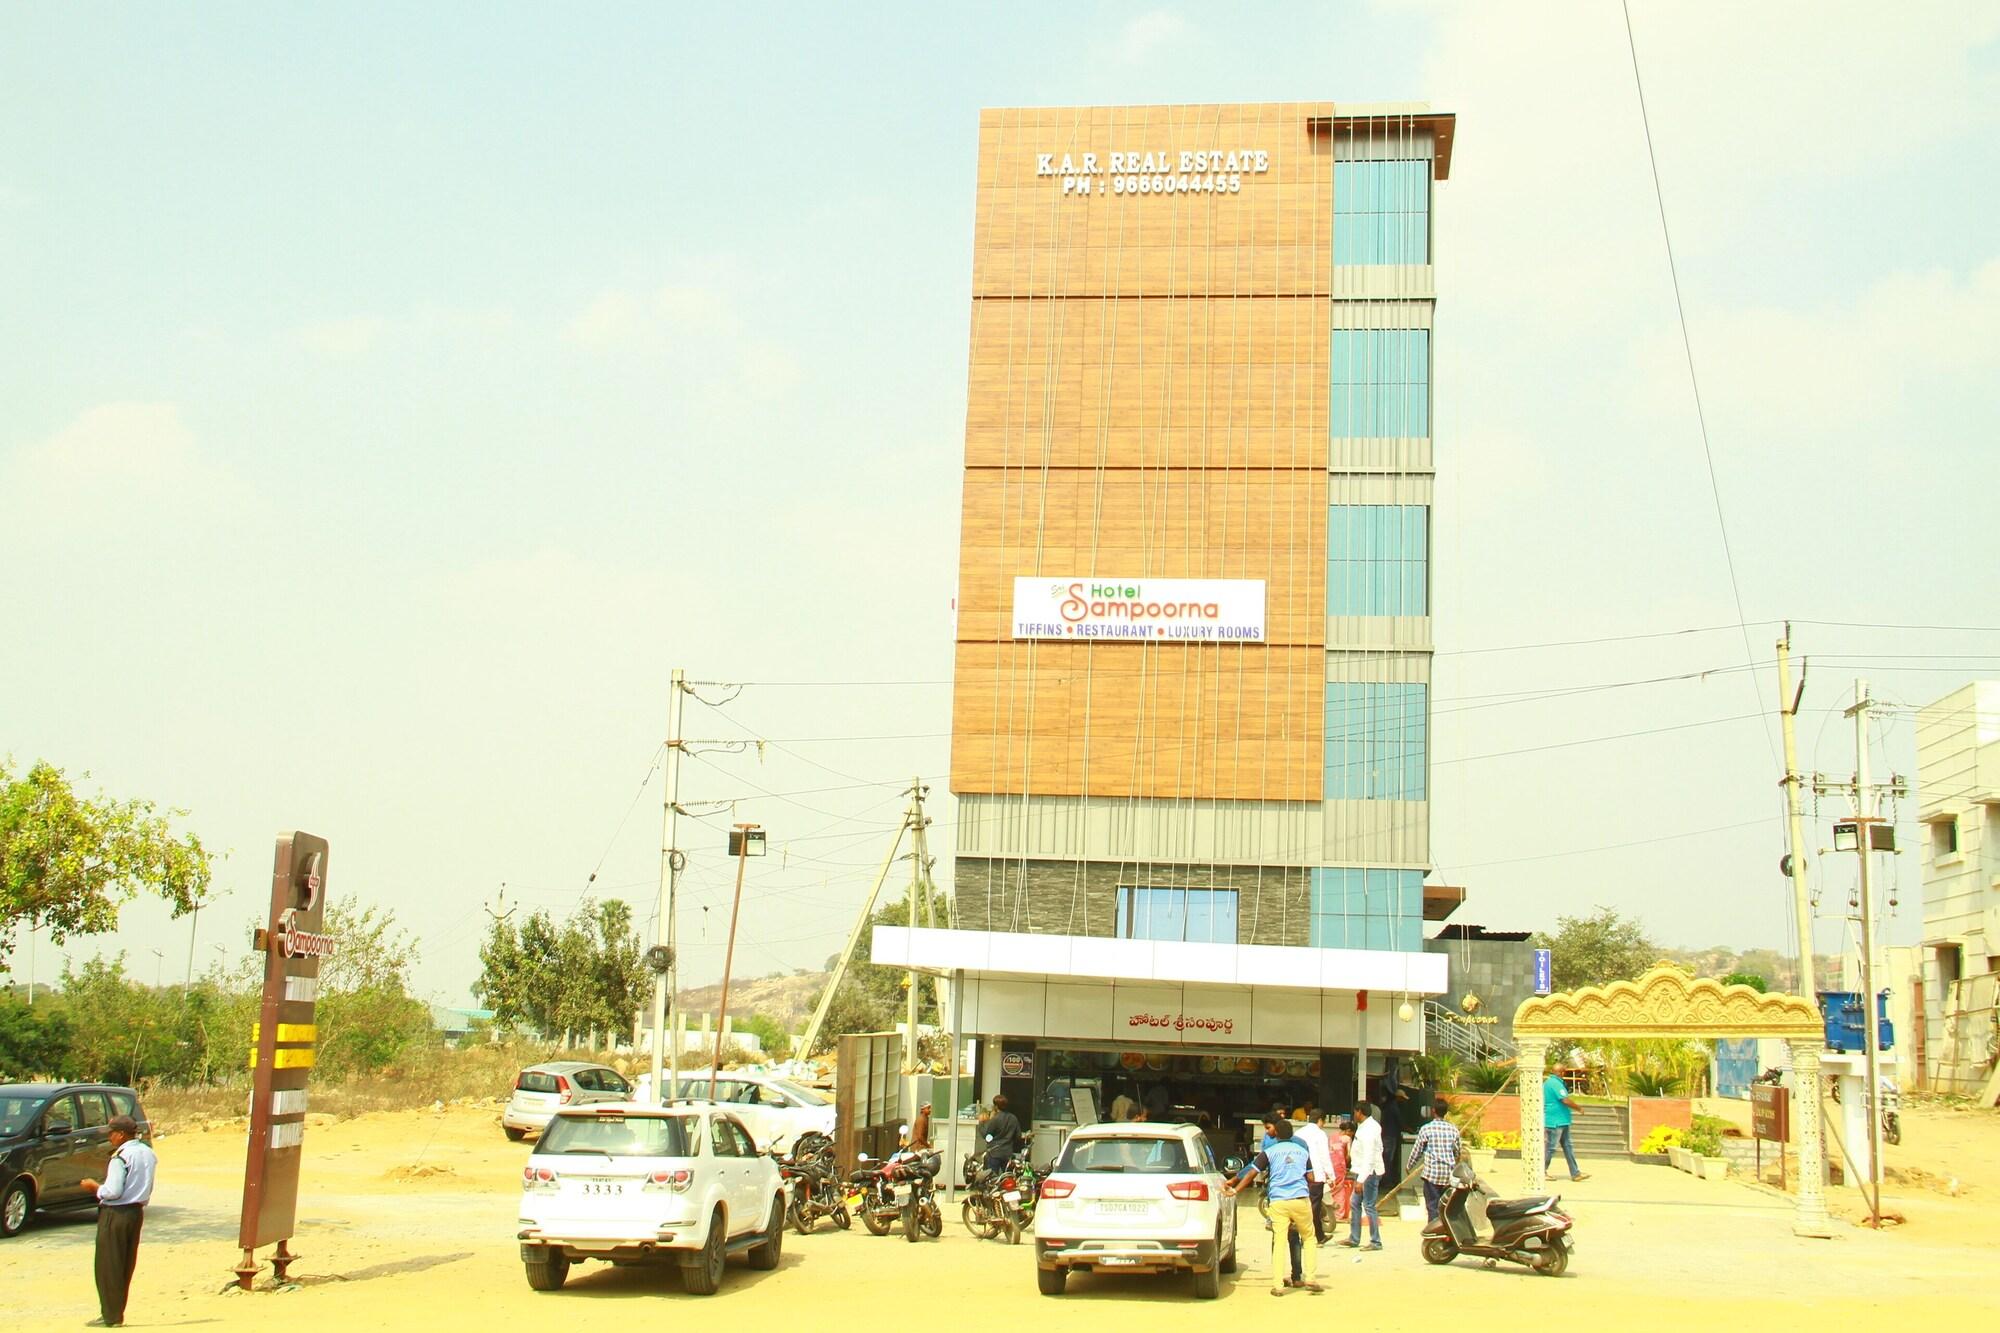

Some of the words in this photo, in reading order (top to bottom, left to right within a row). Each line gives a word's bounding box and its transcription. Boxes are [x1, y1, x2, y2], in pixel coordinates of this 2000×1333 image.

[1036, 152, 1104, 175] K.A.R.
[1110, 151, 1171, 174] REAL
[1179, 150, 1269, 173] ESTATE
[1063, 176, 1090, 194] PH
[1114, 174, 1241, 194] 9666044455
[1091, 584, 1141, 599] Hotel
[1060, 583, 1219, 622] Sampoorna
[1018, 623, 1062, 636] TIFFINS
[1077, 624, 1153, 638] RESTAURANT
[1168, 625, 1212, 639] LUXURY
[1218, 626, 1260, 639] ROOMS
[285, 910, 334, 959] Sampoorna
[1129, 1013, 1171, 1028] హోటల్
